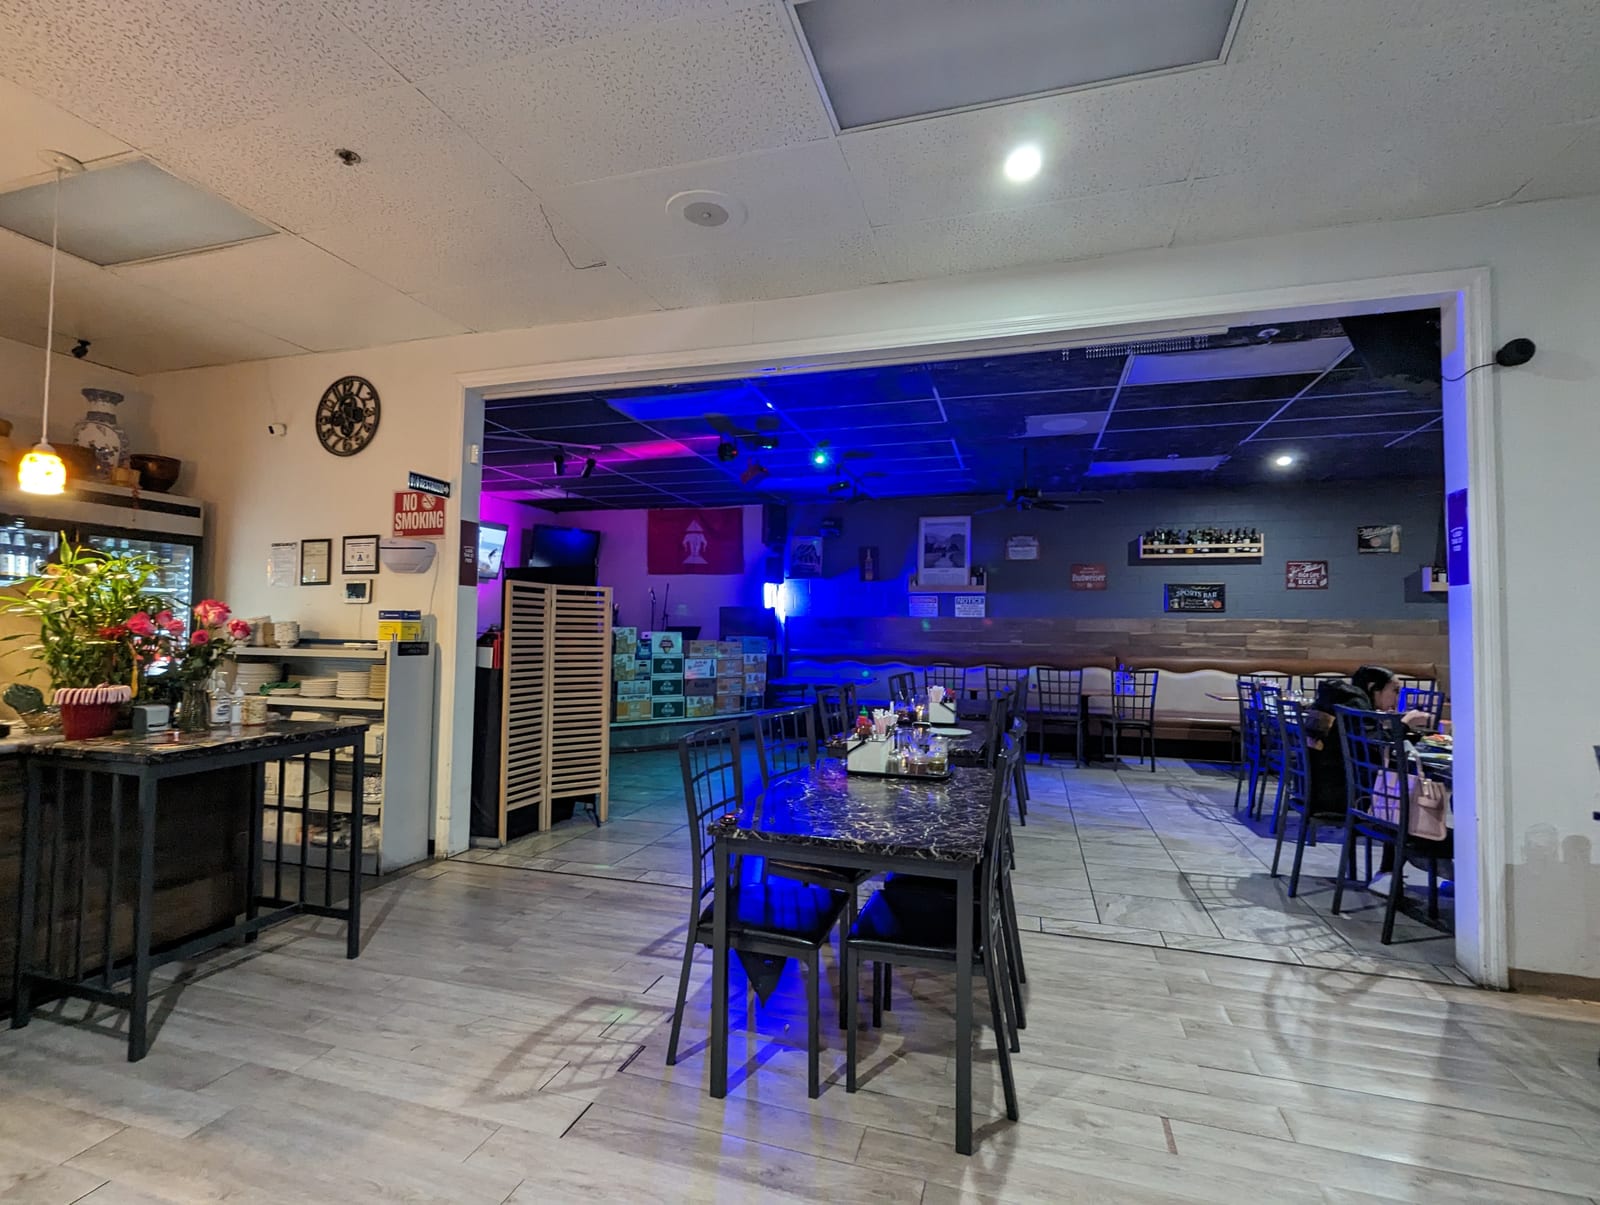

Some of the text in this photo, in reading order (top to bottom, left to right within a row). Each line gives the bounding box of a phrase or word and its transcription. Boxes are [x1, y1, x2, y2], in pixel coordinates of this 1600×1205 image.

[403, 493, 418, 511] NO
[395, 511, 444, 530] SMOKING
[1175, 589, 1218, 599] SPORTS BAR
